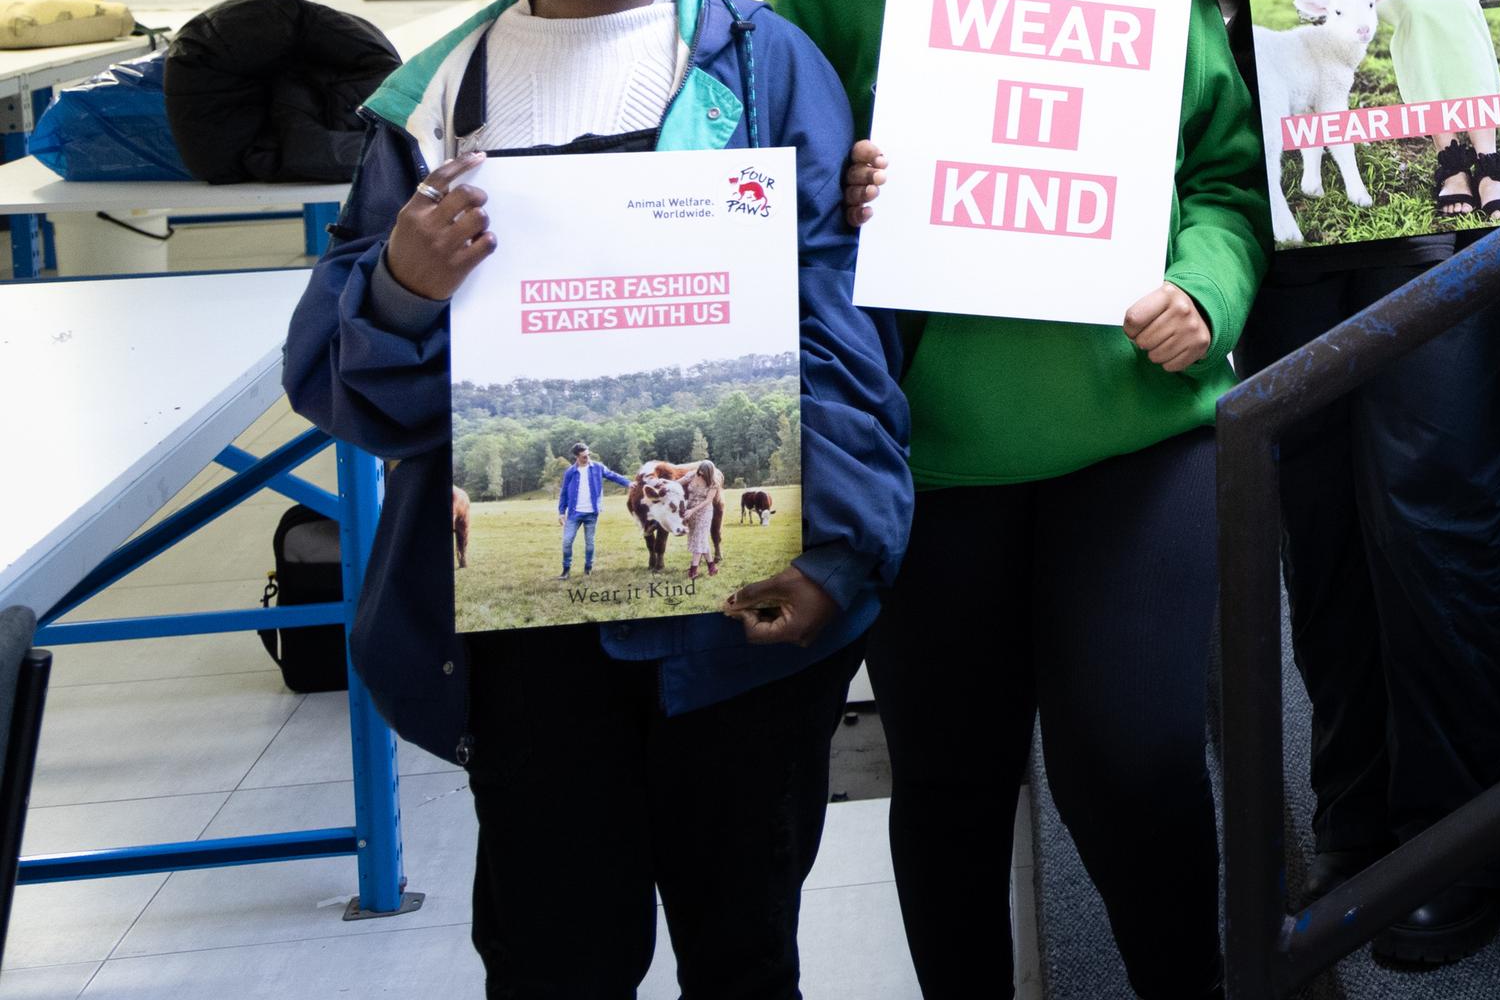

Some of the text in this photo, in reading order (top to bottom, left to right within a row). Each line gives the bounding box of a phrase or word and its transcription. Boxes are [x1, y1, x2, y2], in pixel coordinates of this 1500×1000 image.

[1005, 86, 1068, 143] IT
[1285, 112, 1391, 147] WEAR
[1400, 105, 1432, 134] IT
[740, 166, 775, 189] FOUR
[628, 198, 714, 208] Animal Welfare.
[726, 200, 771, 218] PAWS
[941, 167, 1108, 235] KIND
[653, 209, 714, 219] Worldwide.
[524, 275, 727, 302] KINDER FASHION
[527, 303, 724, 331] STARTS WITH US
[568, 579, 696, 603] Wear it Kind
